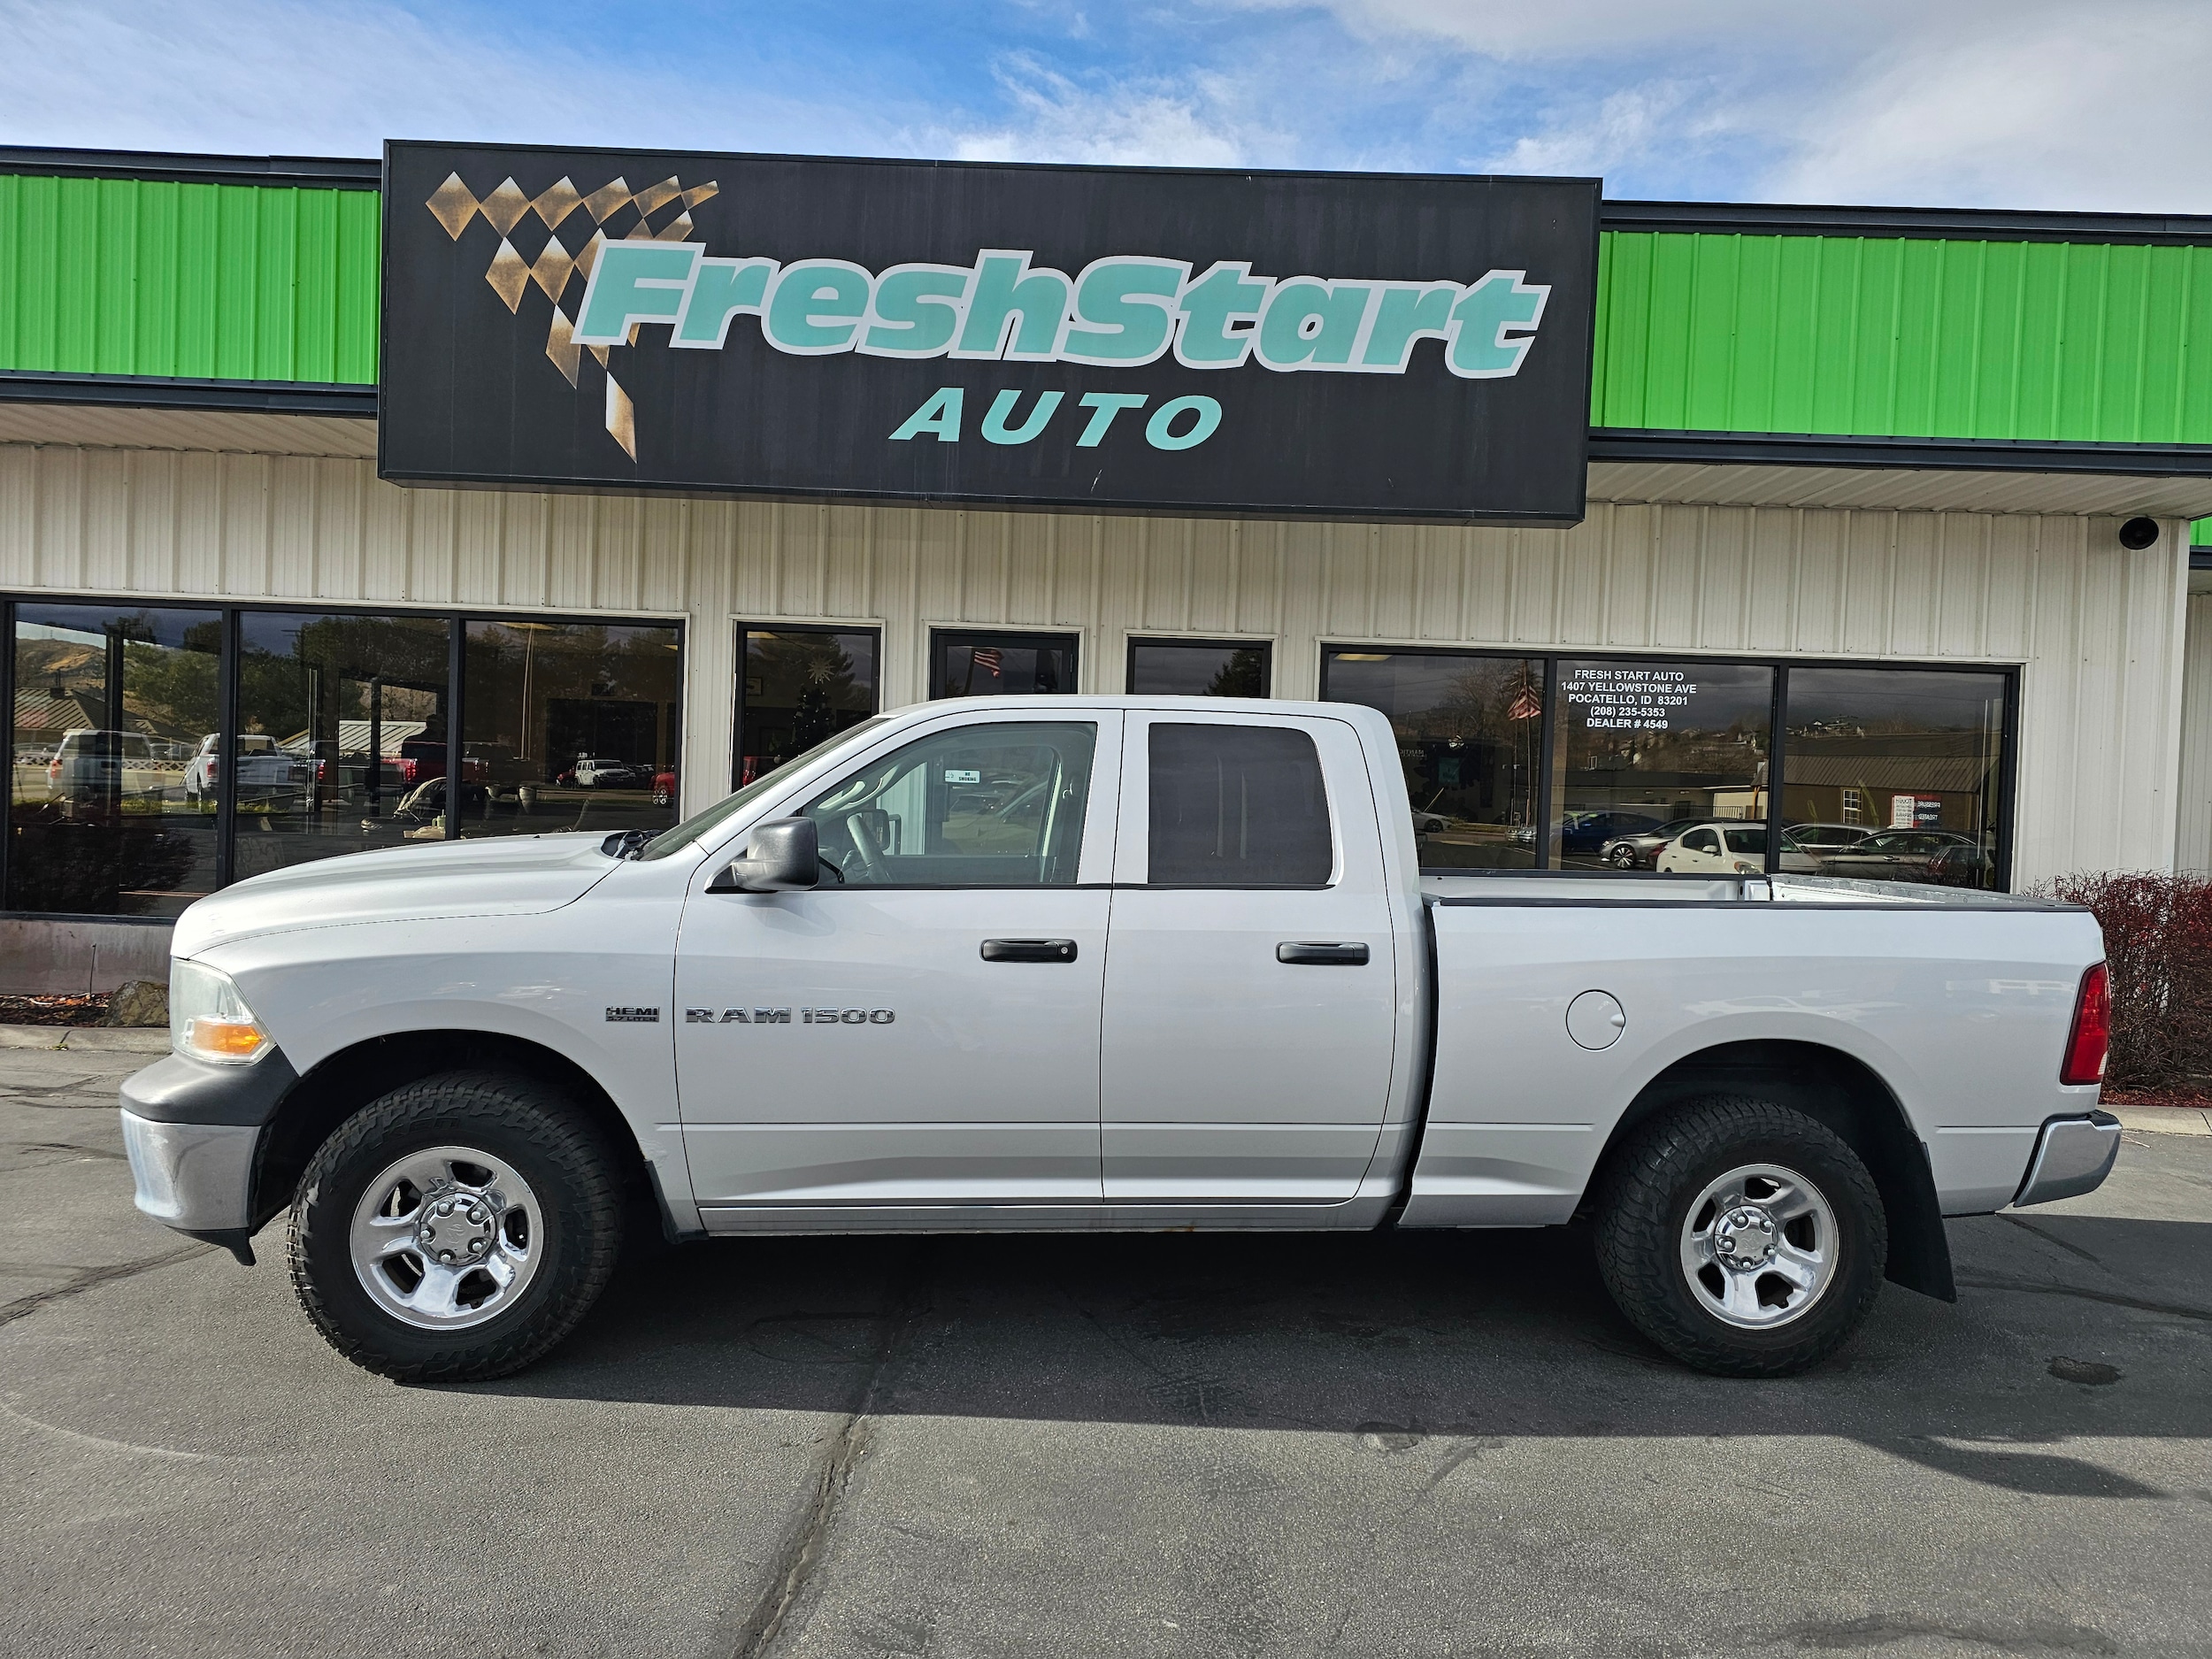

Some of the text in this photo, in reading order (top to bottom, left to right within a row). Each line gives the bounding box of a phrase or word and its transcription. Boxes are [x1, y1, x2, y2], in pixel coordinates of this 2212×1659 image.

[571, 239, 1554, 380] FreshStart
[888, 387, 1223, 451] AUTO
[1574, 669, 1685, 681] FRESH START AUTO
[1561, 681, 1697, 694] 1407 YELLOWSTONE AVE
[1568, 694, 1688, 706] POCATELLO, ID 83201
[1590, 706, 1665, 718] (208) 235-5353
[1586, 718, 1669, 730] DEALER # 4549
[605, 1006, 659, 1016] HEMI
[686, 1006, 895, 1025] RAM 1500
